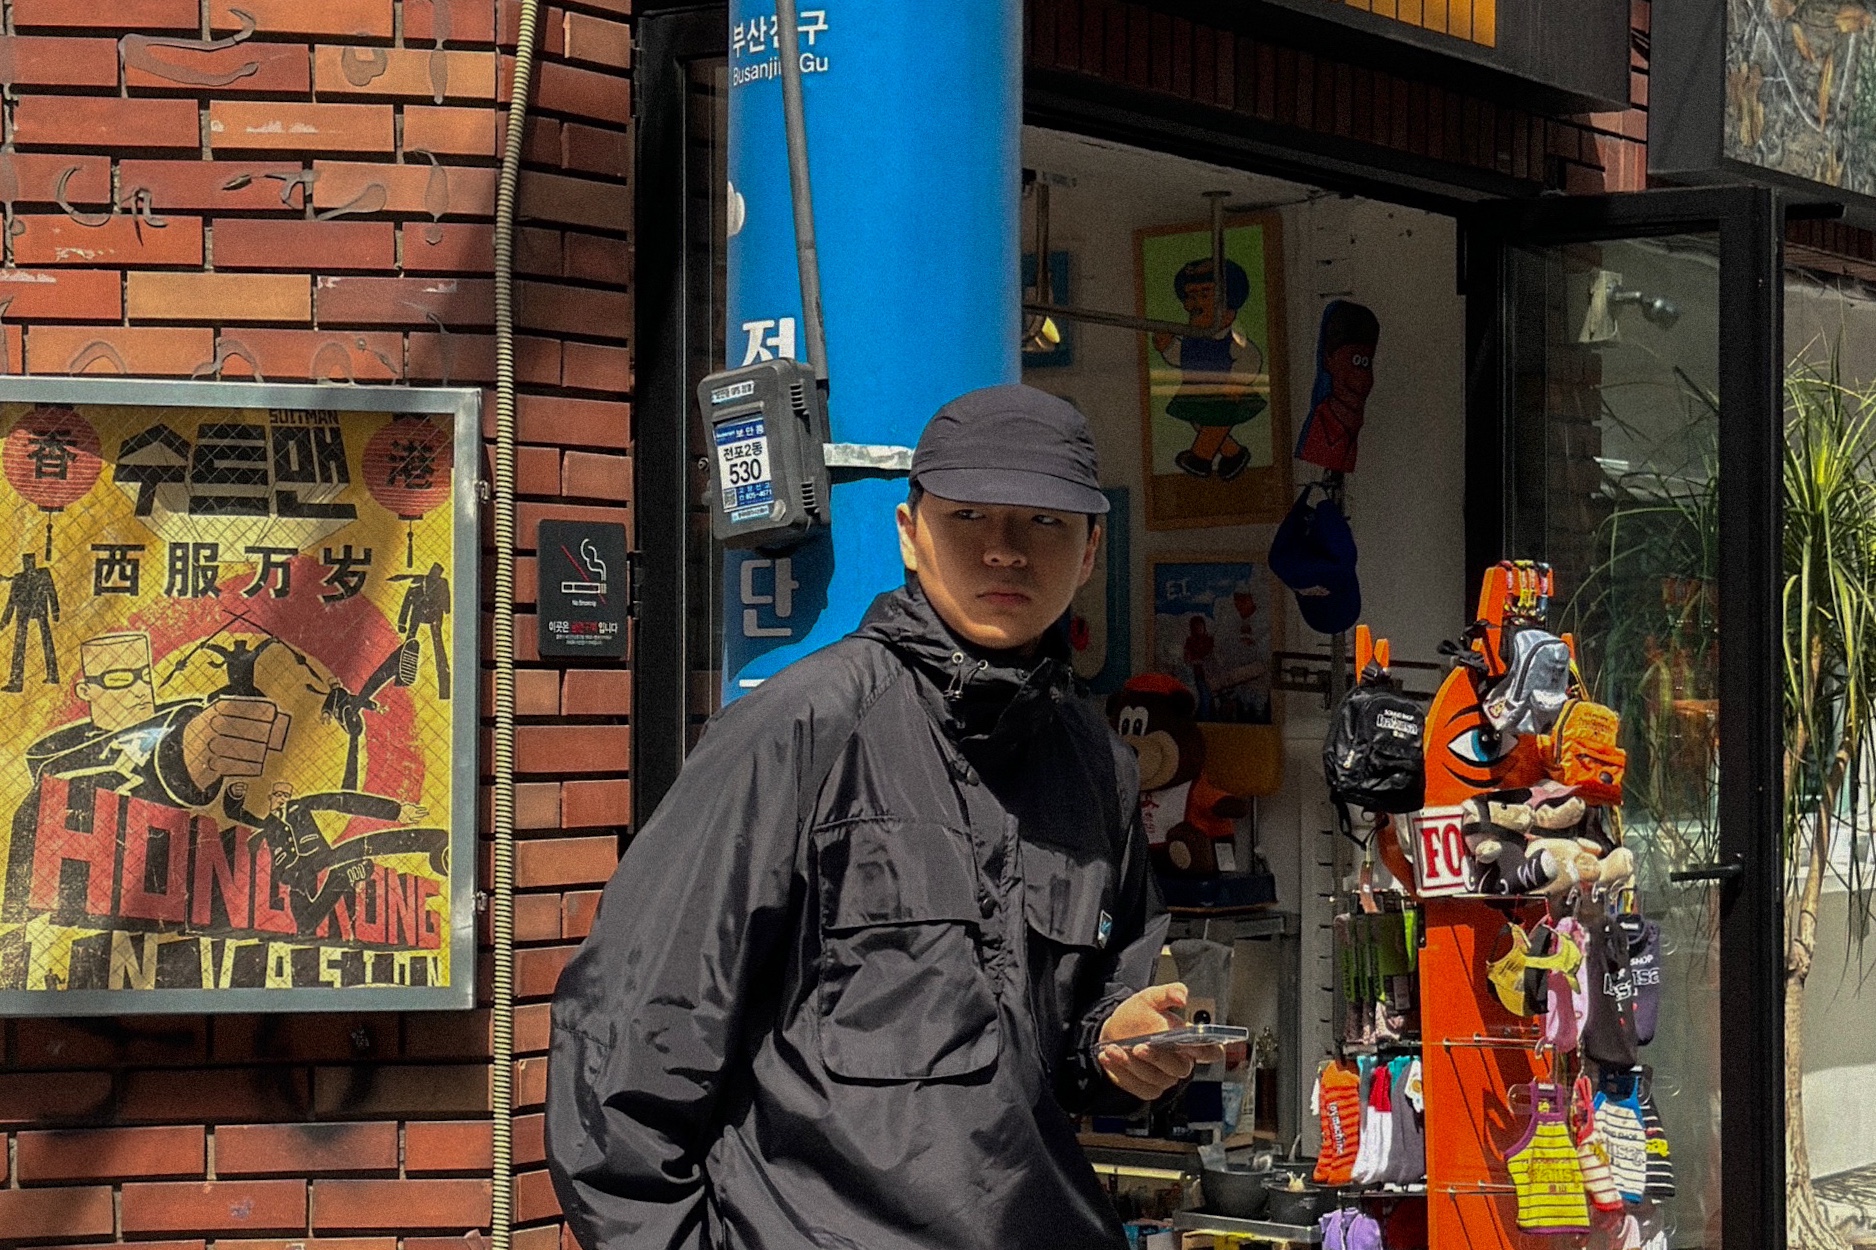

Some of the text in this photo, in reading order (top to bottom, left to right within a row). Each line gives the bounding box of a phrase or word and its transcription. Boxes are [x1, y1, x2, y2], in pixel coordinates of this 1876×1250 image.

[799, 52, 829, 73] Gu
[27, 430, 78, 481] 香
[387, 439, 438, 491] 港
[723, 441, 763, 461] 전포2동
[729, 458, 762, 485] 530
[91, 541, 373, 605] 西服万岁
[548, 621, 570, 633] 이곳은
[598, 621, 618, 634] 입니다
[28, 773, 298, 934] HONG
